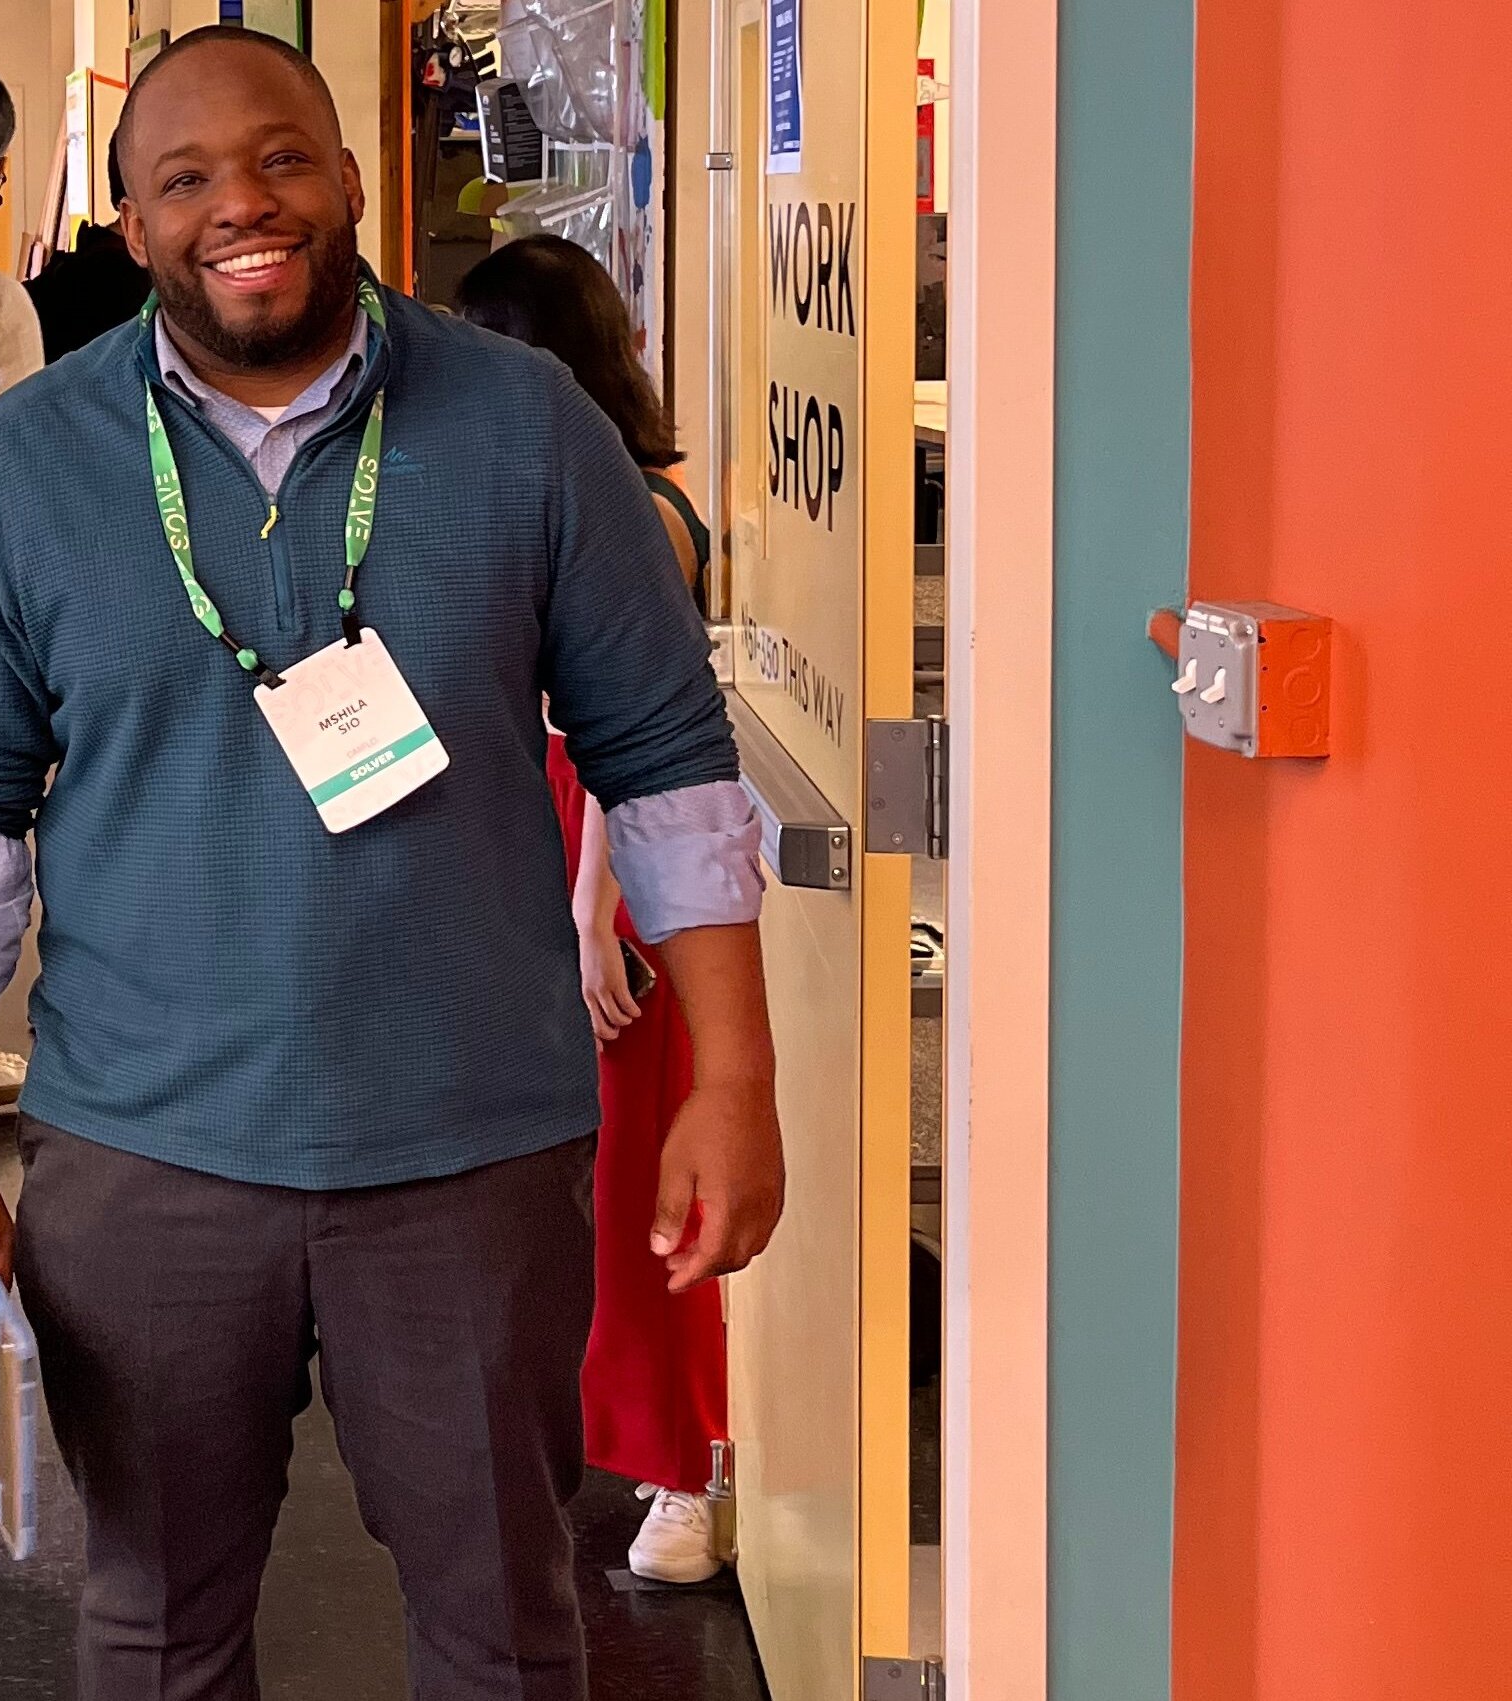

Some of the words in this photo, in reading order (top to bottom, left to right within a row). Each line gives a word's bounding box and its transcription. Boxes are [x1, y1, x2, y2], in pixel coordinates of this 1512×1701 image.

[769, 202, 856, 337] WORK
[769, 380, 844, 532] SHOP
[318, 698, 369, 732] MSHILA
[337, 716, 361, 736] SIO
[782, 637, 809, 713] THIS
[812, 665, 844, 749] WAY
[349, 750, 396, 781] SOLVER
